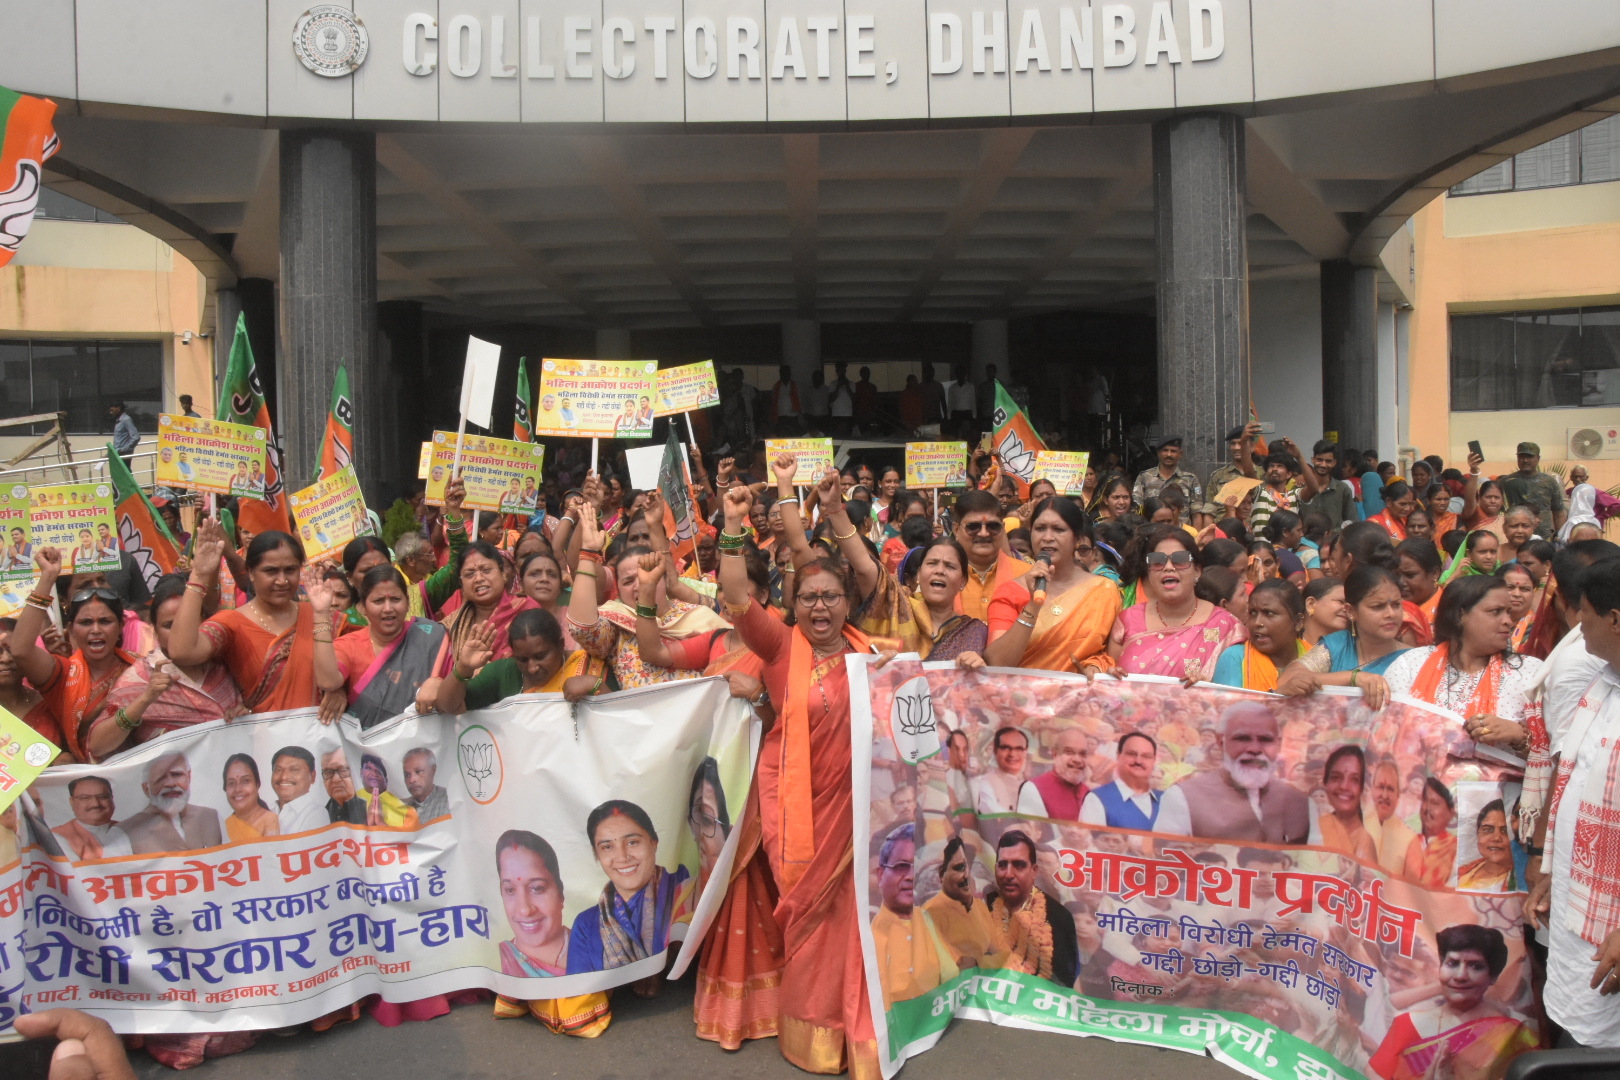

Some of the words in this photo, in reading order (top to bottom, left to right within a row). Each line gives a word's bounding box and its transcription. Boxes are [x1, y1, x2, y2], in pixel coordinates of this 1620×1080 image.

[402, 12, 898, 84] COLLECTORATE,
[930, 0, 1225, 75] DHANBAD
[546, 379, 578, 388] महिला
[581, 380, 616, 389] आक्रोश
[620, 380, 652, 390] प्रदर्शन
[163, 433, 194, 444] महिला
[196, 438, 230, 449] आक्रोश
[233, 443, 262, 454] प्रदर्शन
[469, 456, 504, 467] आक्रोश
[507, 459, 538, 471] प्रदर्शन
[67, 505, 108, 519] प्रदर्शन
[297, 505, 320, 519] महिला
[81, 855, 263, 905] आक्रोश
[276, 836, 412, 883] प्रदर्शन
[35, 894, 141, 941] निकम्मी
[151, 905, 184, 937] है,
[192, 901, 223, 934] वो
[232, 885, 330, 925] सरकार
[336, 872, 421, 907] बदलनी
[427, 865, 447, 897] है
[1052, 847, 1258, 910] आक्रोश
[1272, 871, 1422, 959] प्रदर्शन
[24, 931, 133, 985] रोधी
[148, 928, 317, 984] सरकार
[1095, 908, 1171, 942] महिला
[1179, 915, 1253, 950] विरोधी
[1262, 922, 1319, 958] हेमंत
[1322, 941, 1377, 990] सरकार
[37, 985, 82, 1004] पार्टी,
[89, 985, 150, 1003] महिला
[156, 984, 201, 1005] मोर्चा,
[205, 983, 283, 1005] महानगर,
[287, 963, 340, 993] धनबाद
[342, 954, 412, 976] विधानसभा
[1139, 950, 1185, 978] गद्दी
[1305, 972, 1342, 1010] छोड़ो
[1032, 988, 1167, 1036] महिला
[1178, 1012, 1279, 1068] मोर्चा,
